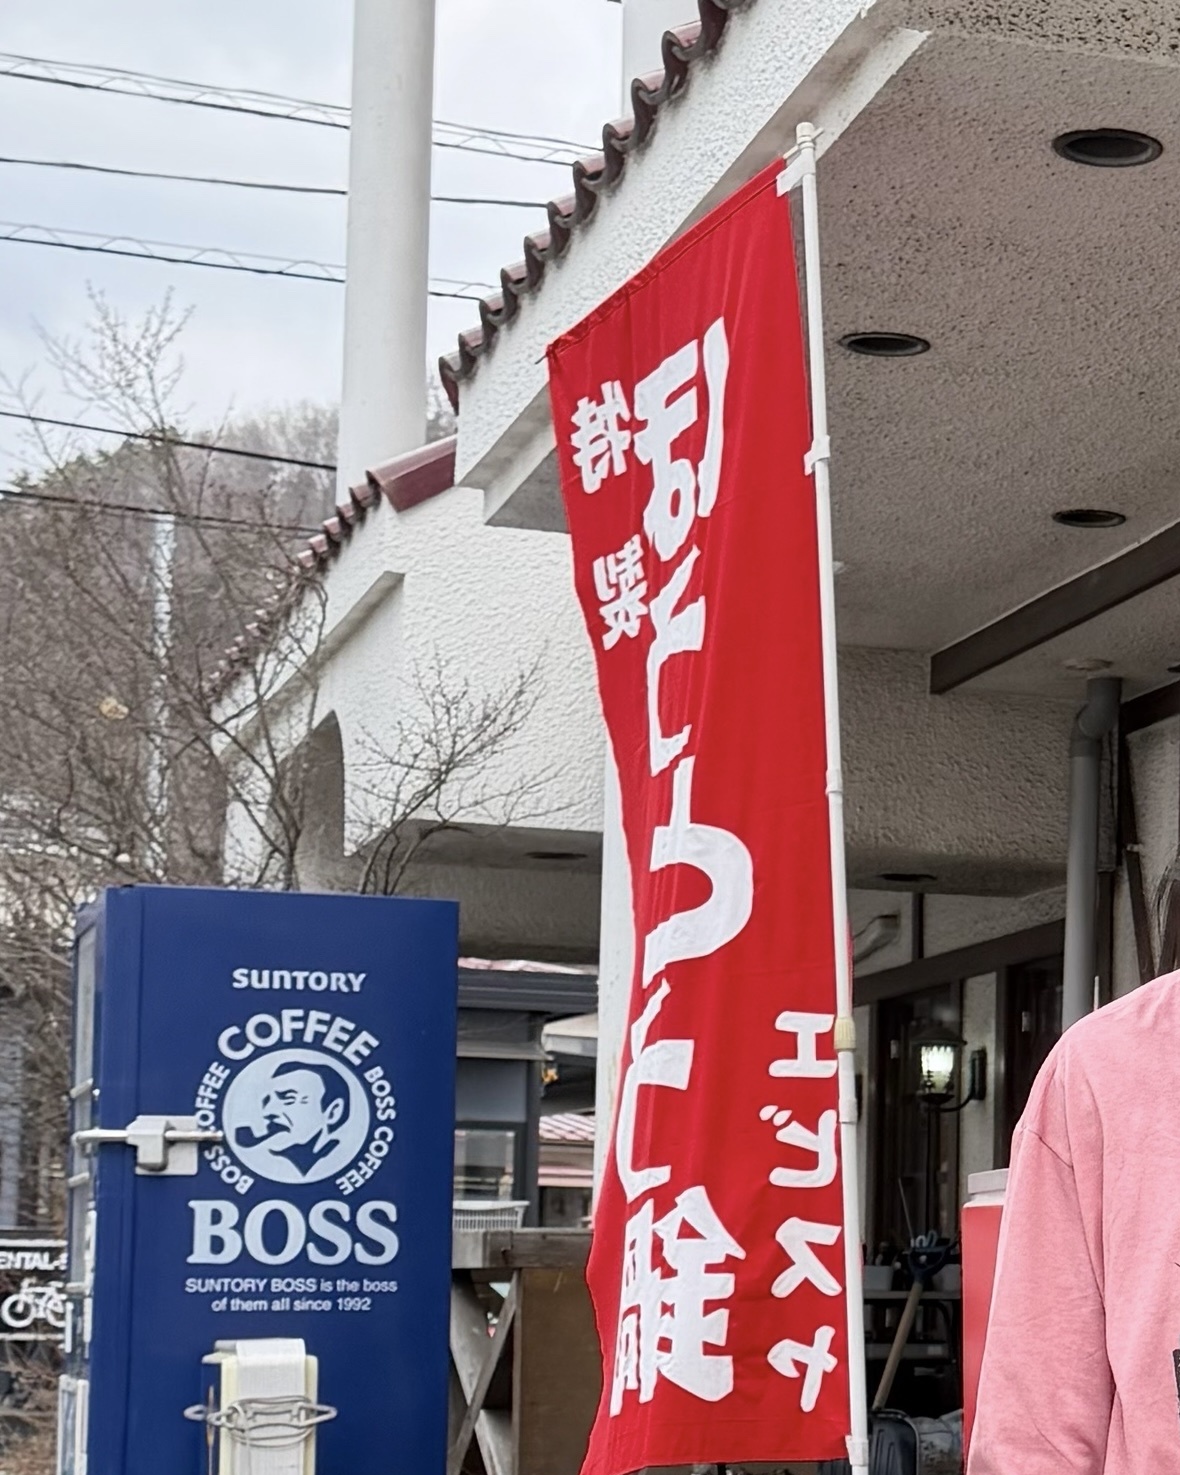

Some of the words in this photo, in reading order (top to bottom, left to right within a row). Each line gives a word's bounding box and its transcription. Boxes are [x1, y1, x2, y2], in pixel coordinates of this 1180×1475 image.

[232, 967, 367, 993] SUNTORY
[217, 1009, 380, 1066] COFFEE
[194, 1061, 231, 1133] OFFEE
[363, 1066, 397, 1121] BOSS
[335, 1126, 394, 1196] COFFEE
[186, 1199, 400, 1266] BOSS
[184, 1277, 268, 1294] SUNTORY
[270, 1277, 317, 1293] BOSS
[320, 1278, 334, 1293] is
[335, 1278, 361, 1293] the
[362, 1278, 399, 1293] boss
[211, 1296, 228, 1312] of
[230, 1297, 269, 1312] them
[270, 1297, 291, 1311] all
[292, 1297, 333, 1311] since
[337, 1297, 372, 1311] 1992
